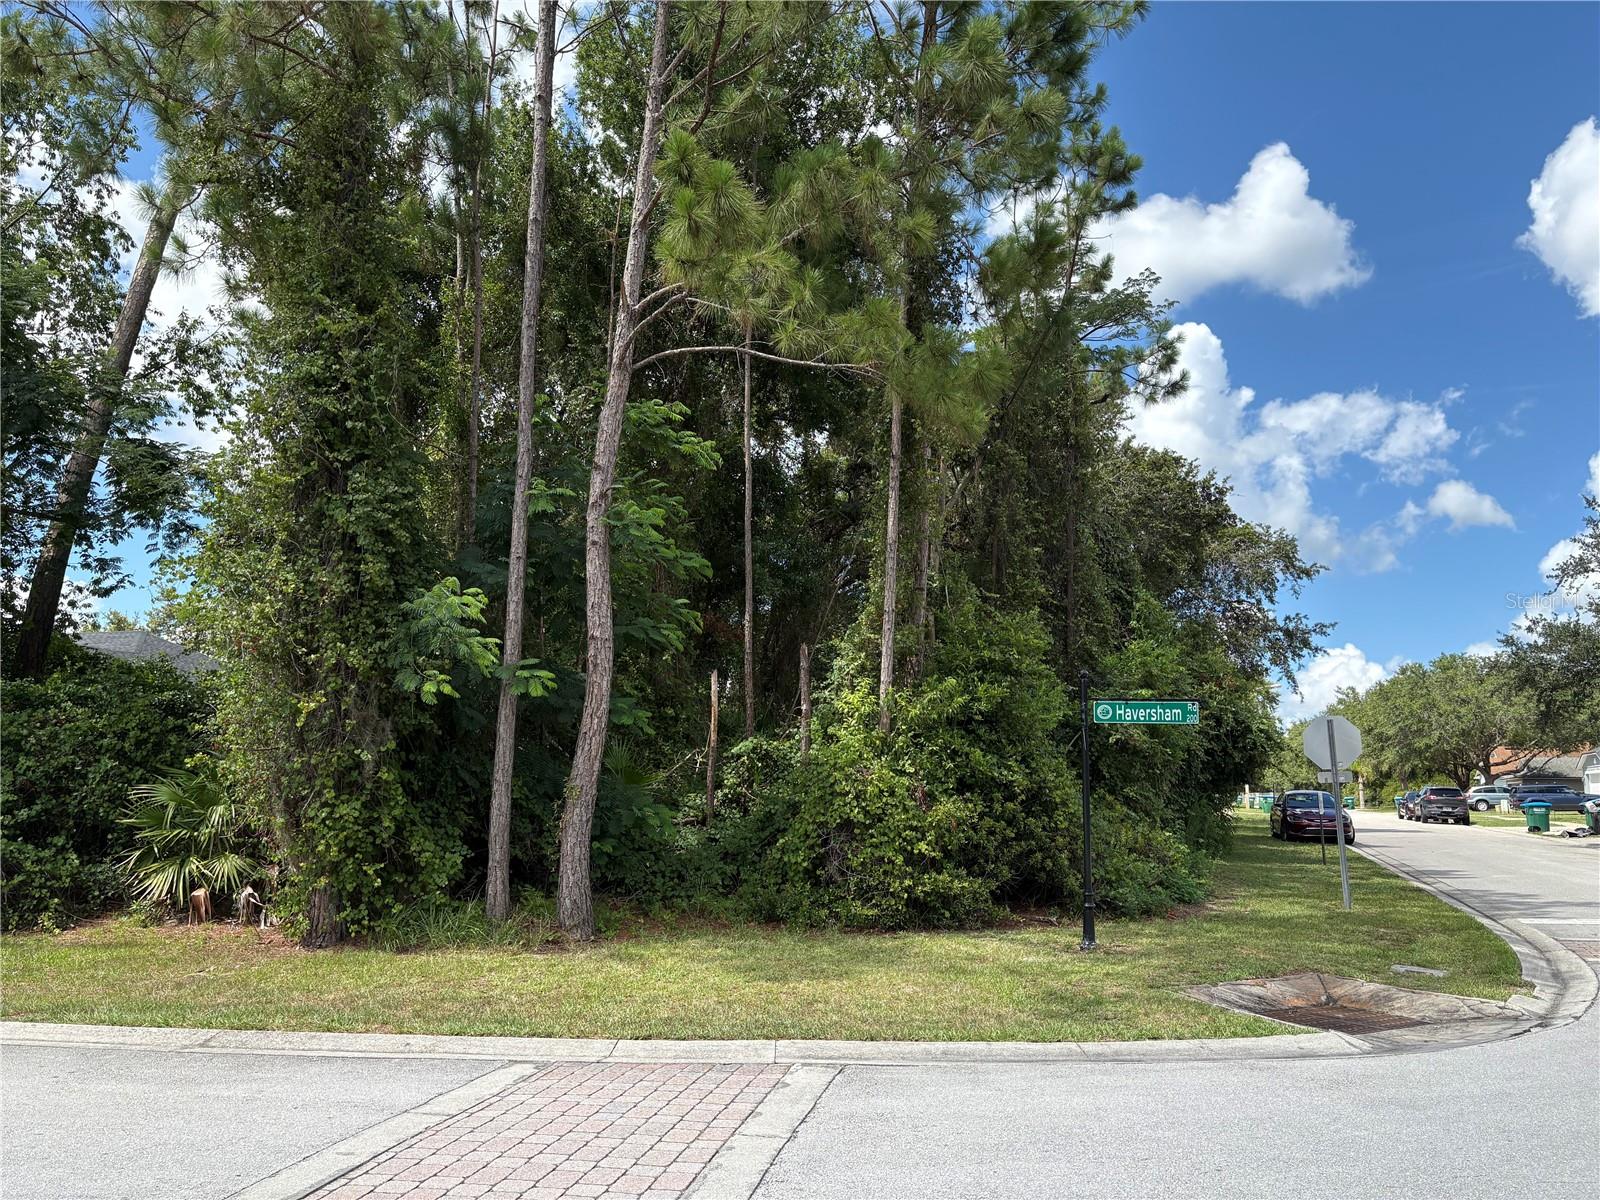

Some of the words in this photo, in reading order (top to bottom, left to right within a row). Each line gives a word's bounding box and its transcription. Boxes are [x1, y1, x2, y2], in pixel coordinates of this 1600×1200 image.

[1116, 704, 1182, 721] Haversham
[1187, 703, 1197, 712] Rd
[1186, 714, 1197, 723] 200
